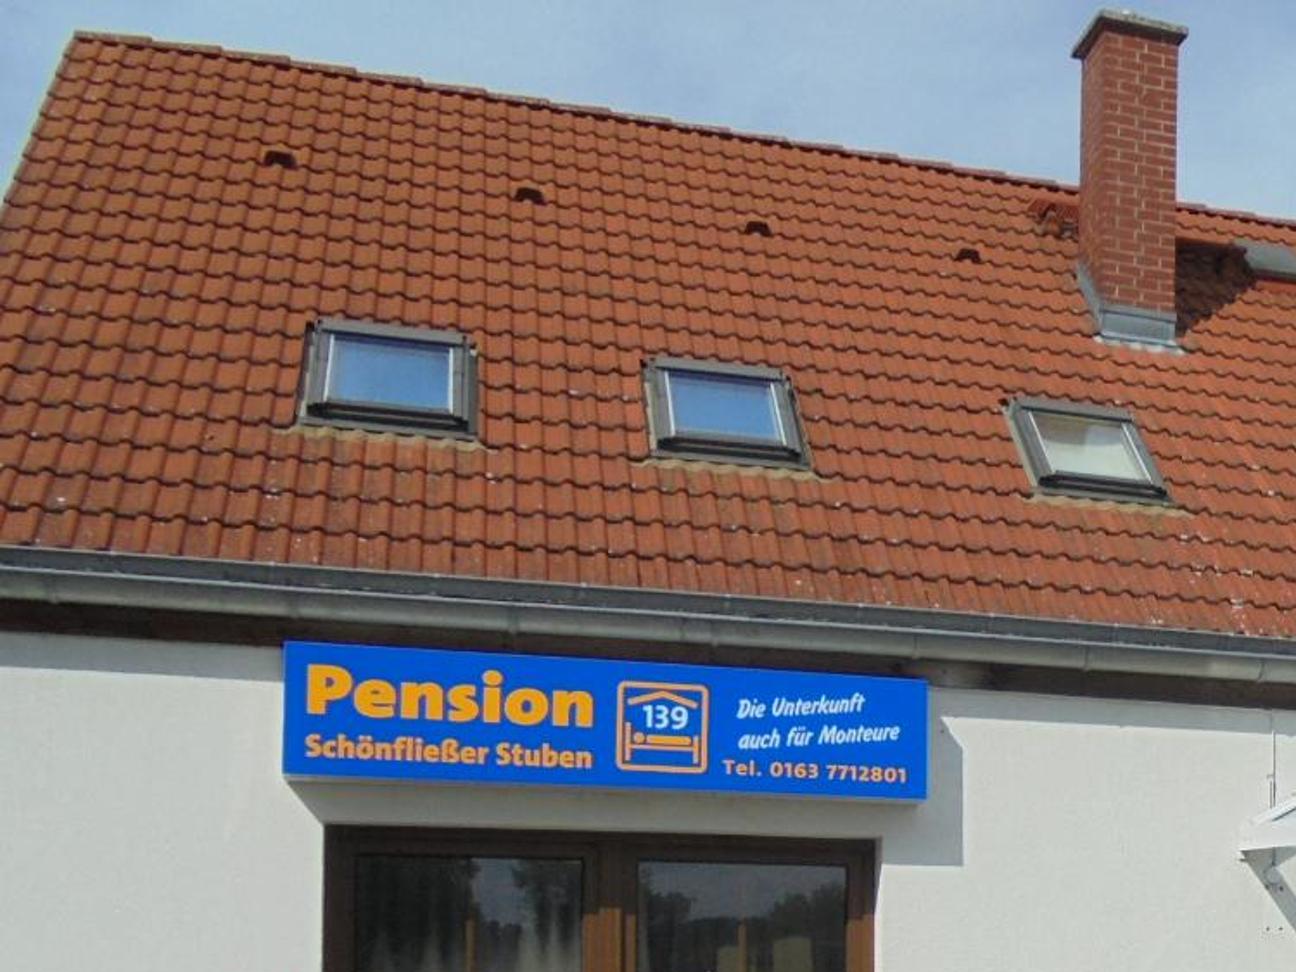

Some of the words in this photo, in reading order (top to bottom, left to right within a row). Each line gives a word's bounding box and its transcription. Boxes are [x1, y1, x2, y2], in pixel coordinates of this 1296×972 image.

[306, 663, 594, 728] Pension
[737, 698, 765, 719] Die
[772, 692, 866, 717] Unterkunft
[642, 704, 688, 730] 139
[738, 729, 780, 750] auch
[786, 726, 814, 747] für
[818, 725, 901, 746] Monteure
[305, 733, 490, 765] Schönfließer
[496, 742, 593, 769] Stuben
[721, 759, 762, 777] Tel.
[769, 761, 819, 780] 0163
[825, 764, 907, 784] 7712801
